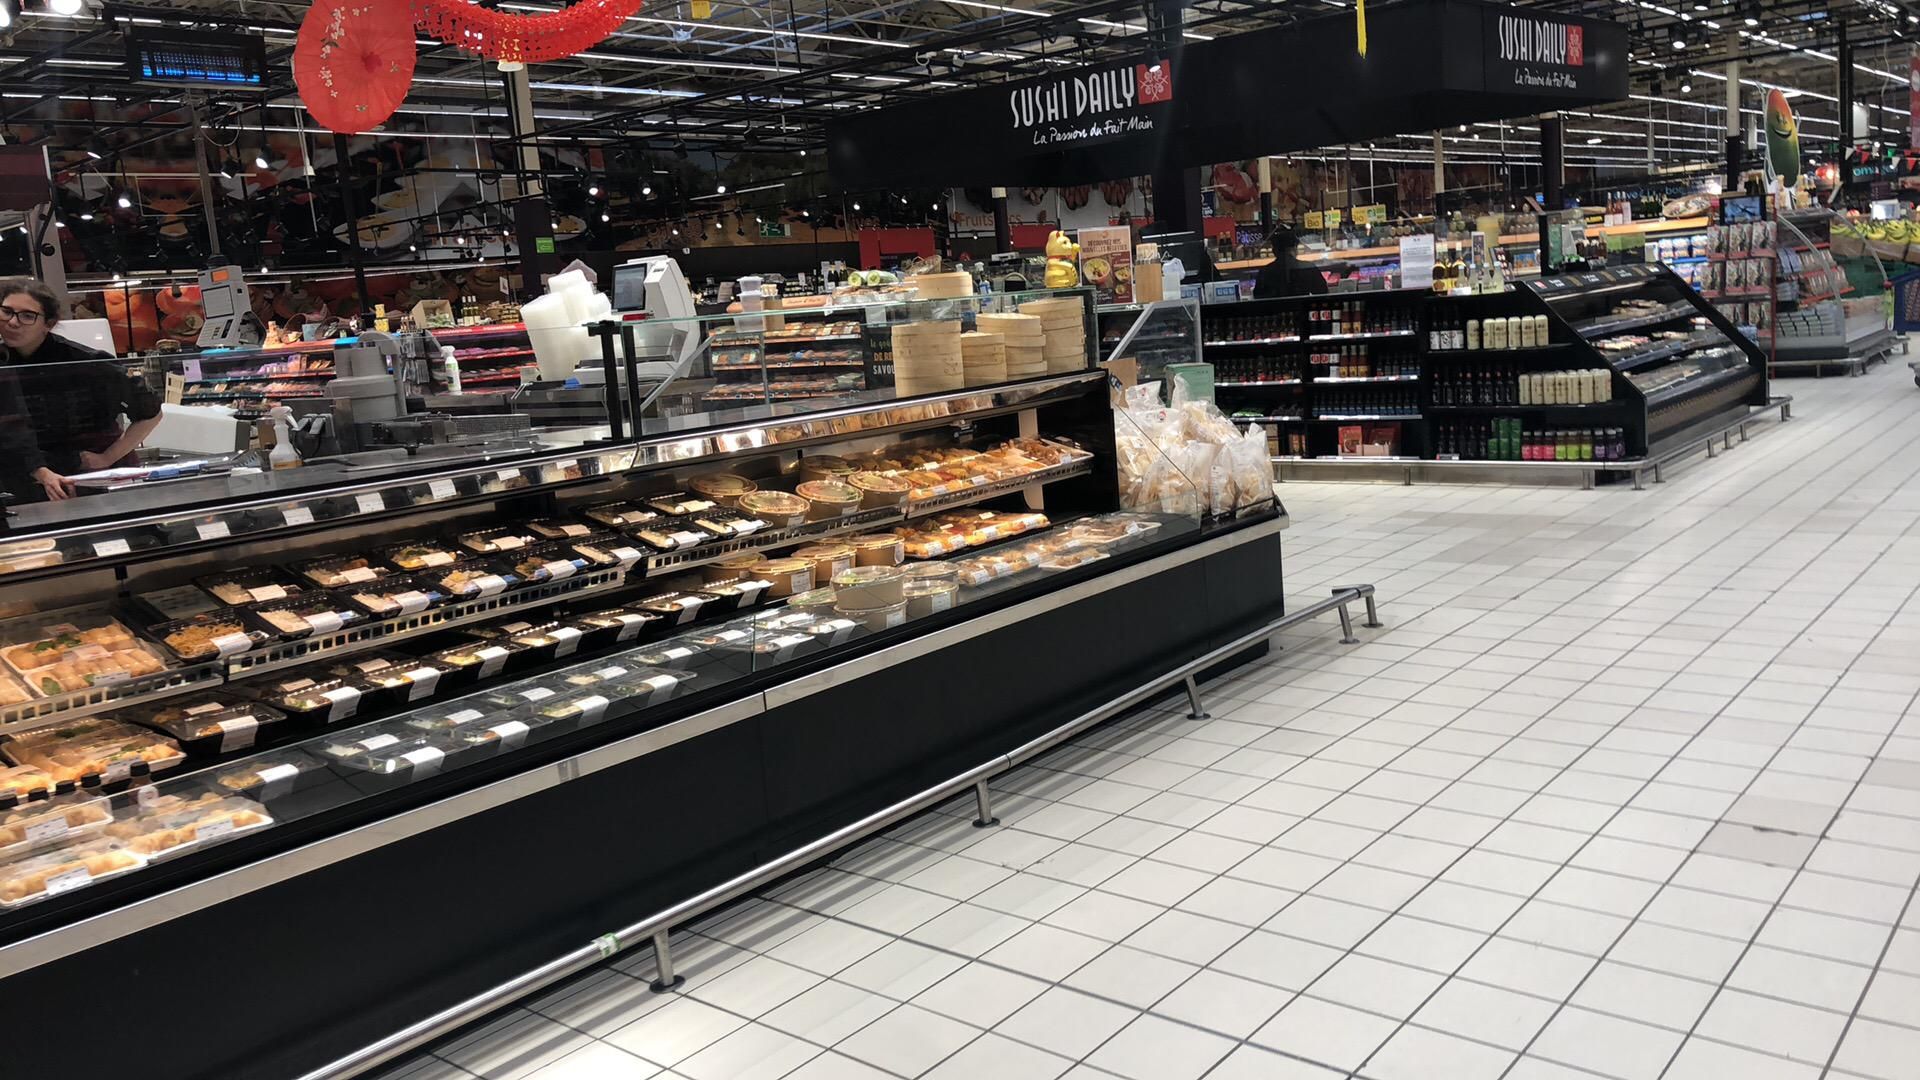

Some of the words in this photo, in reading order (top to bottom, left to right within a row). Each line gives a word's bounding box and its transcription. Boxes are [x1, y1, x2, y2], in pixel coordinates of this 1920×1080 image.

[1499, 15, 1532, 62] SUSHI
[1535, 19, 1566, 65] DAILY
[1010, 80, 1068, 129] SUSHI
[1074, 66, 1135, 117] DAILY
[1033, 130, 1048, 145] La
[1049, 125, 1088, 143] Passion
[1089, 122, 1103, 137] du
[1104, 117, 1128, 136] Fait
[1127, 115, 1153, 131] Main
